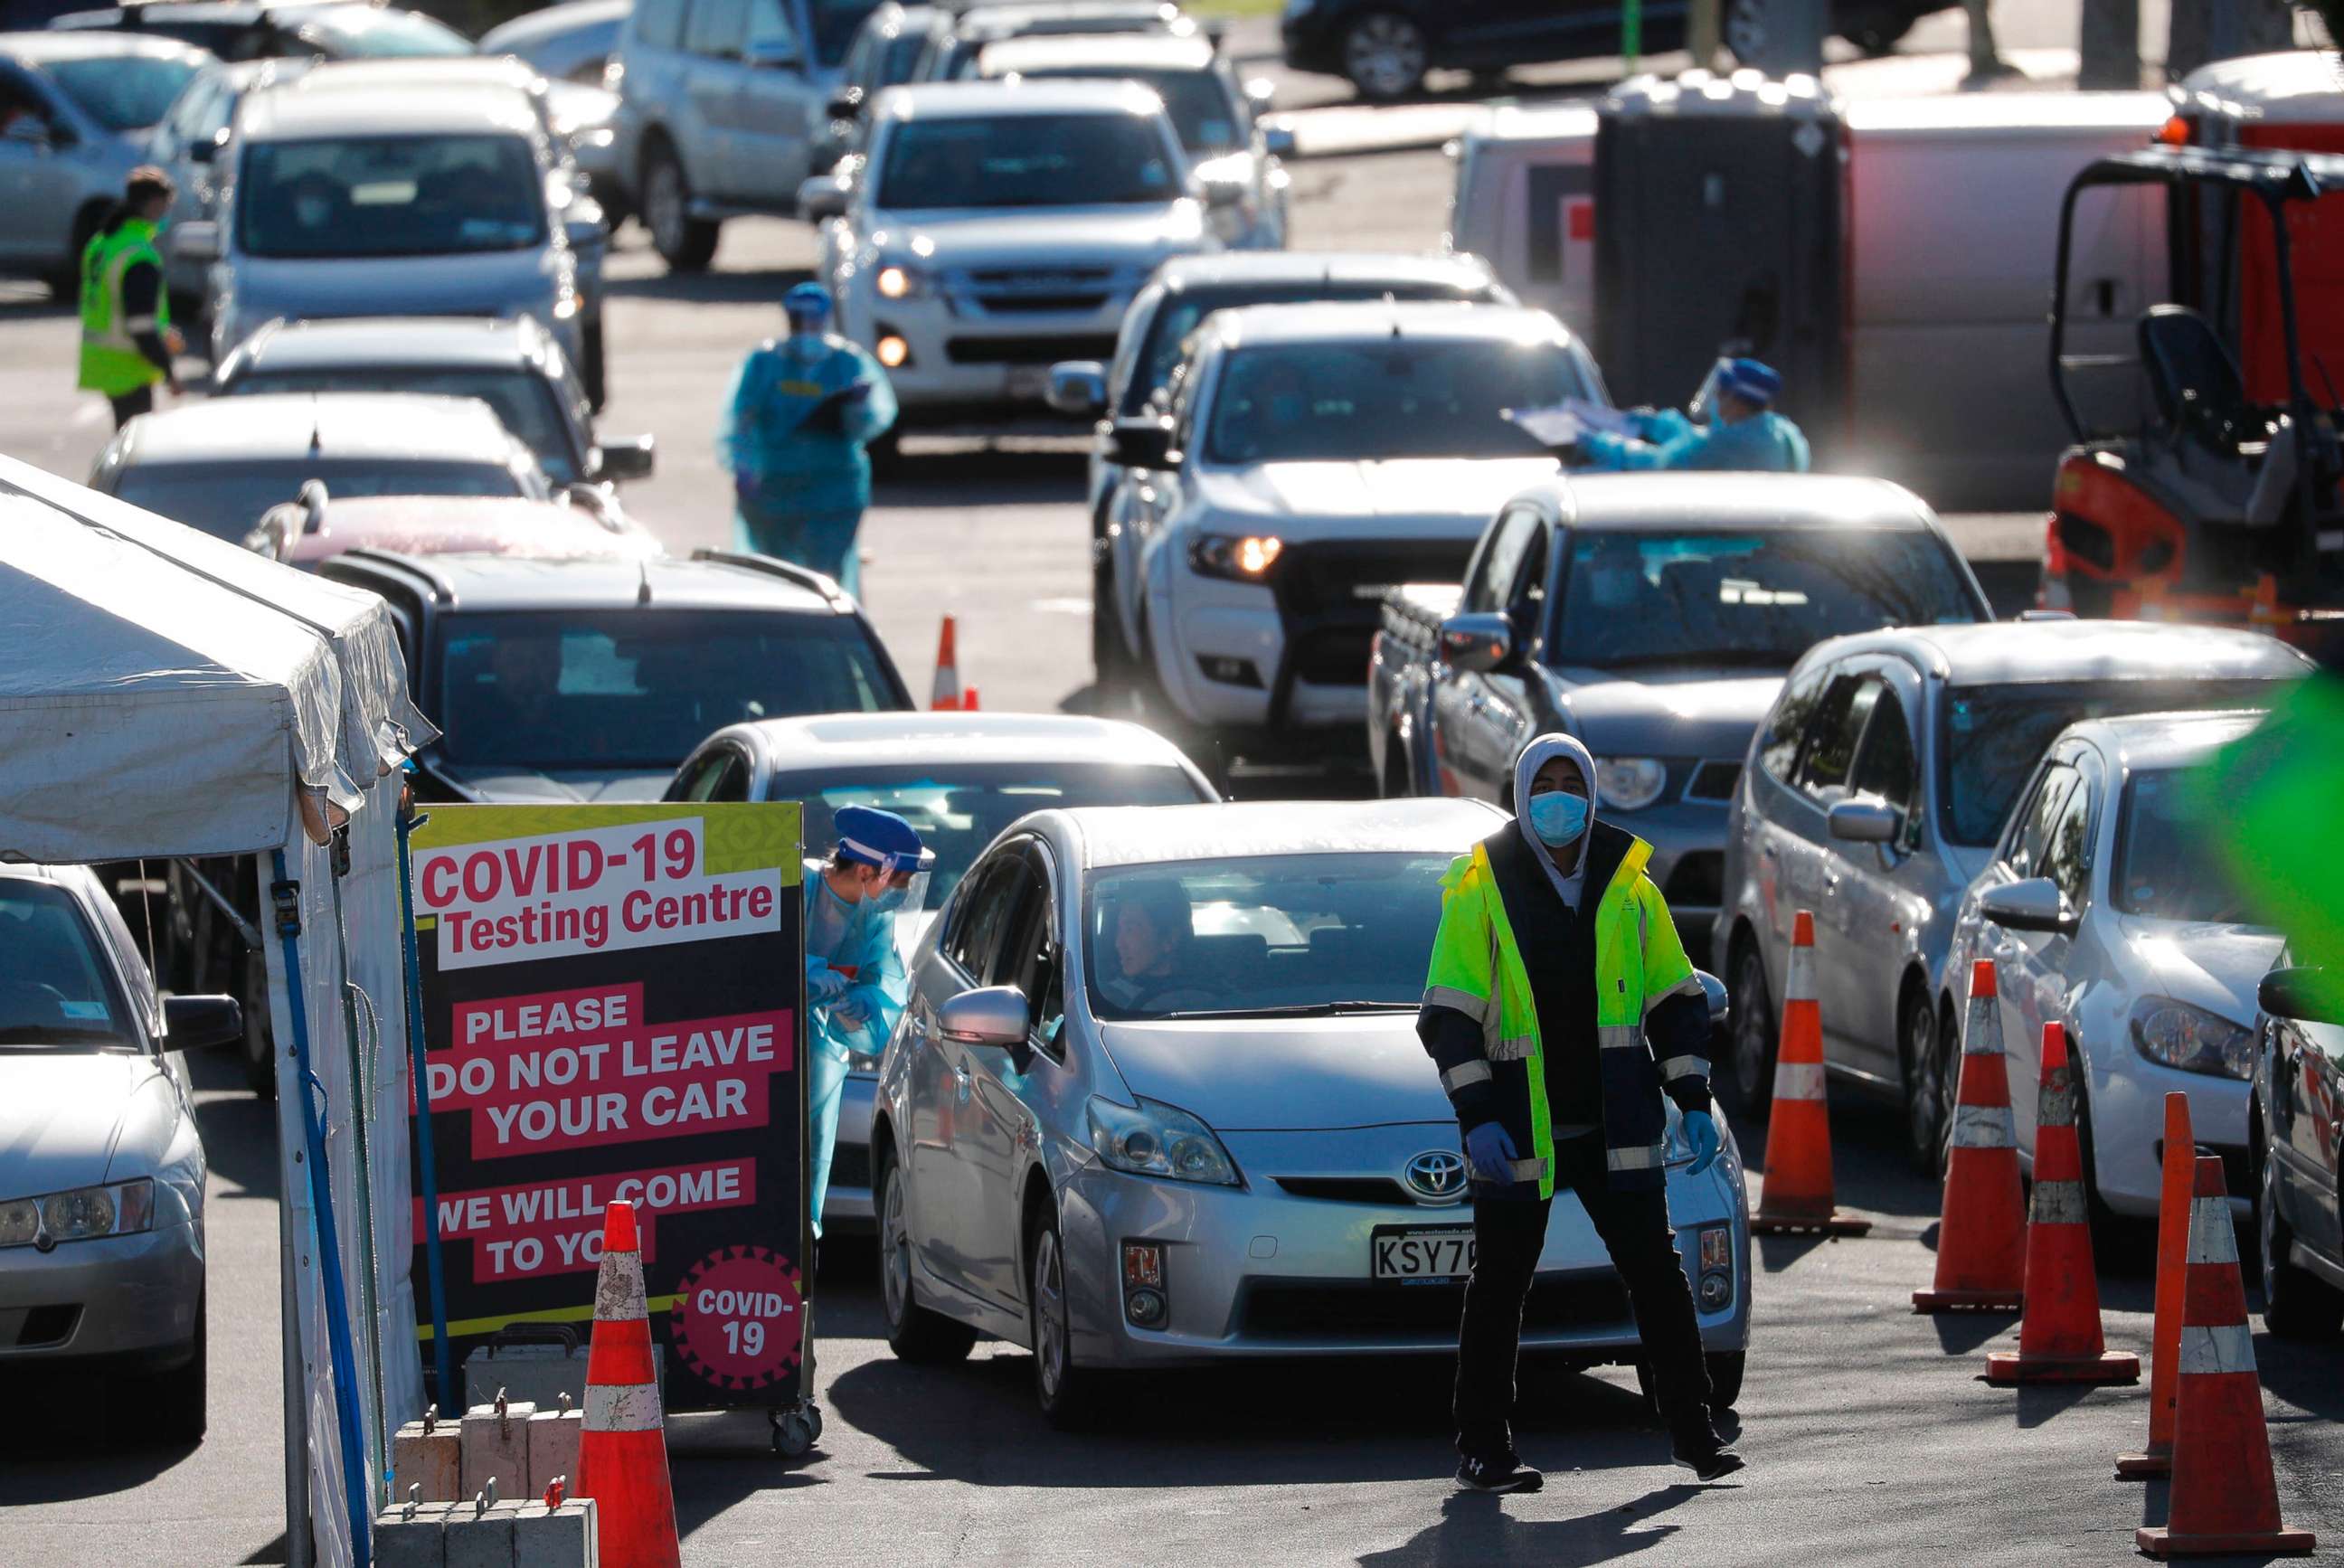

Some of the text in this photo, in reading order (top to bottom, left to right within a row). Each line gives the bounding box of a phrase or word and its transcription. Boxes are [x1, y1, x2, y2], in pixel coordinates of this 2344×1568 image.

[422, 828, 695, 908] COVID-19
[444, 883, 773, 954] Testing Centre
[467, 995, 628, 1044] PLEASE
[426, 1025, 774, 1100] DO NOT LEAVE
[487, 1079, 748, 1144] YOUR CAR
[438, 1167, 740, 1234] WE WILL COME
[487, 1225, 641, 1273] TO YO
[697, 1289, 793, 1318] COVID-
[723, 1321, 764, 1355] 19
